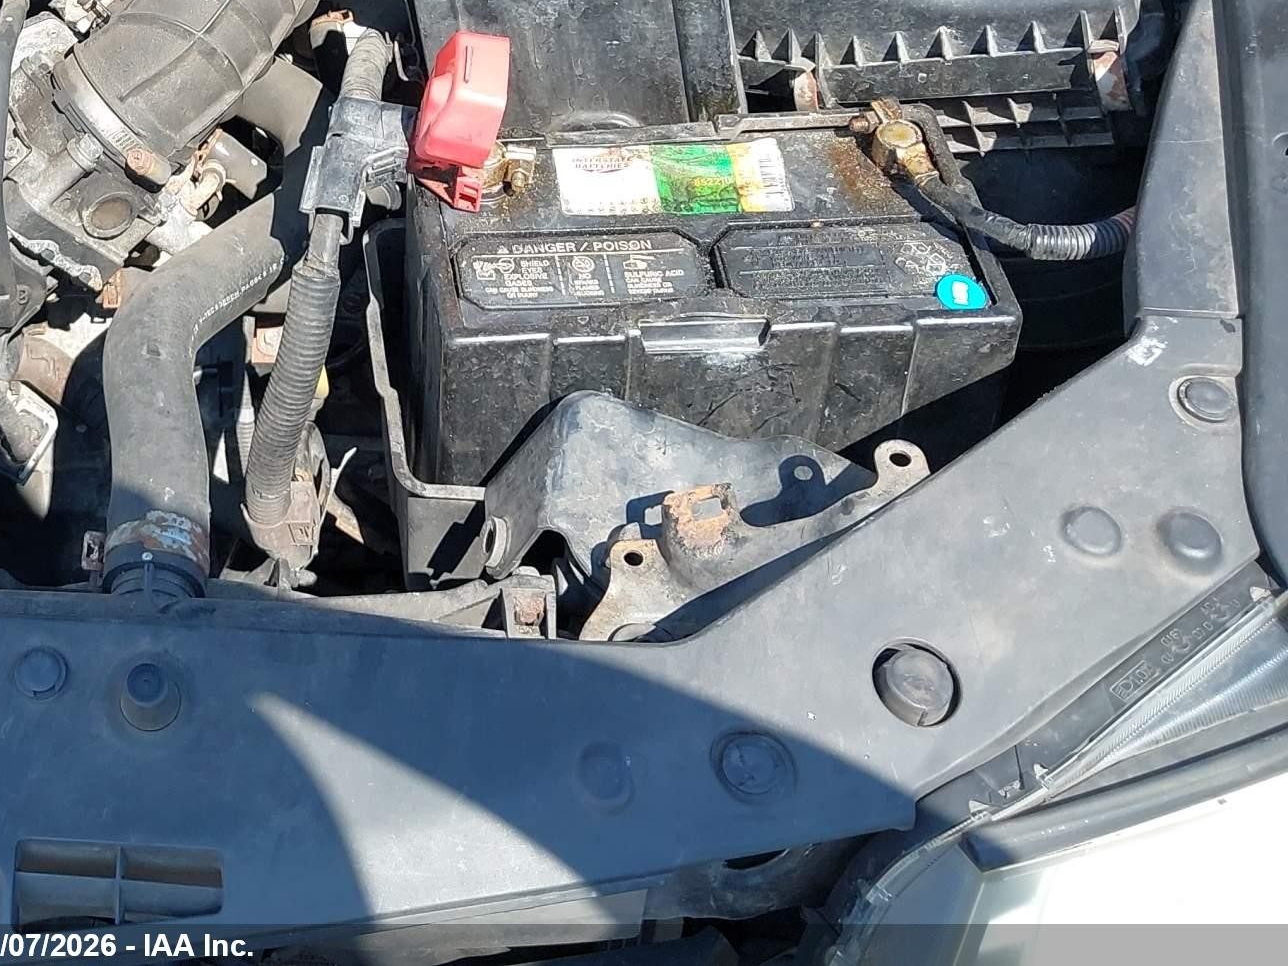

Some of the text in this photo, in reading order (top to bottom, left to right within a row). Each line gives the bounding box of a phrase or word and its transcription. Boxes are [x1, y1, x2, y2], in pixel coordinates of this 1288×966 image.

[512, 242, 576, 254] DANGER
[593, 239, 652, 252] POISON
[624, 269, 685, 278] SULFURIC ACID
